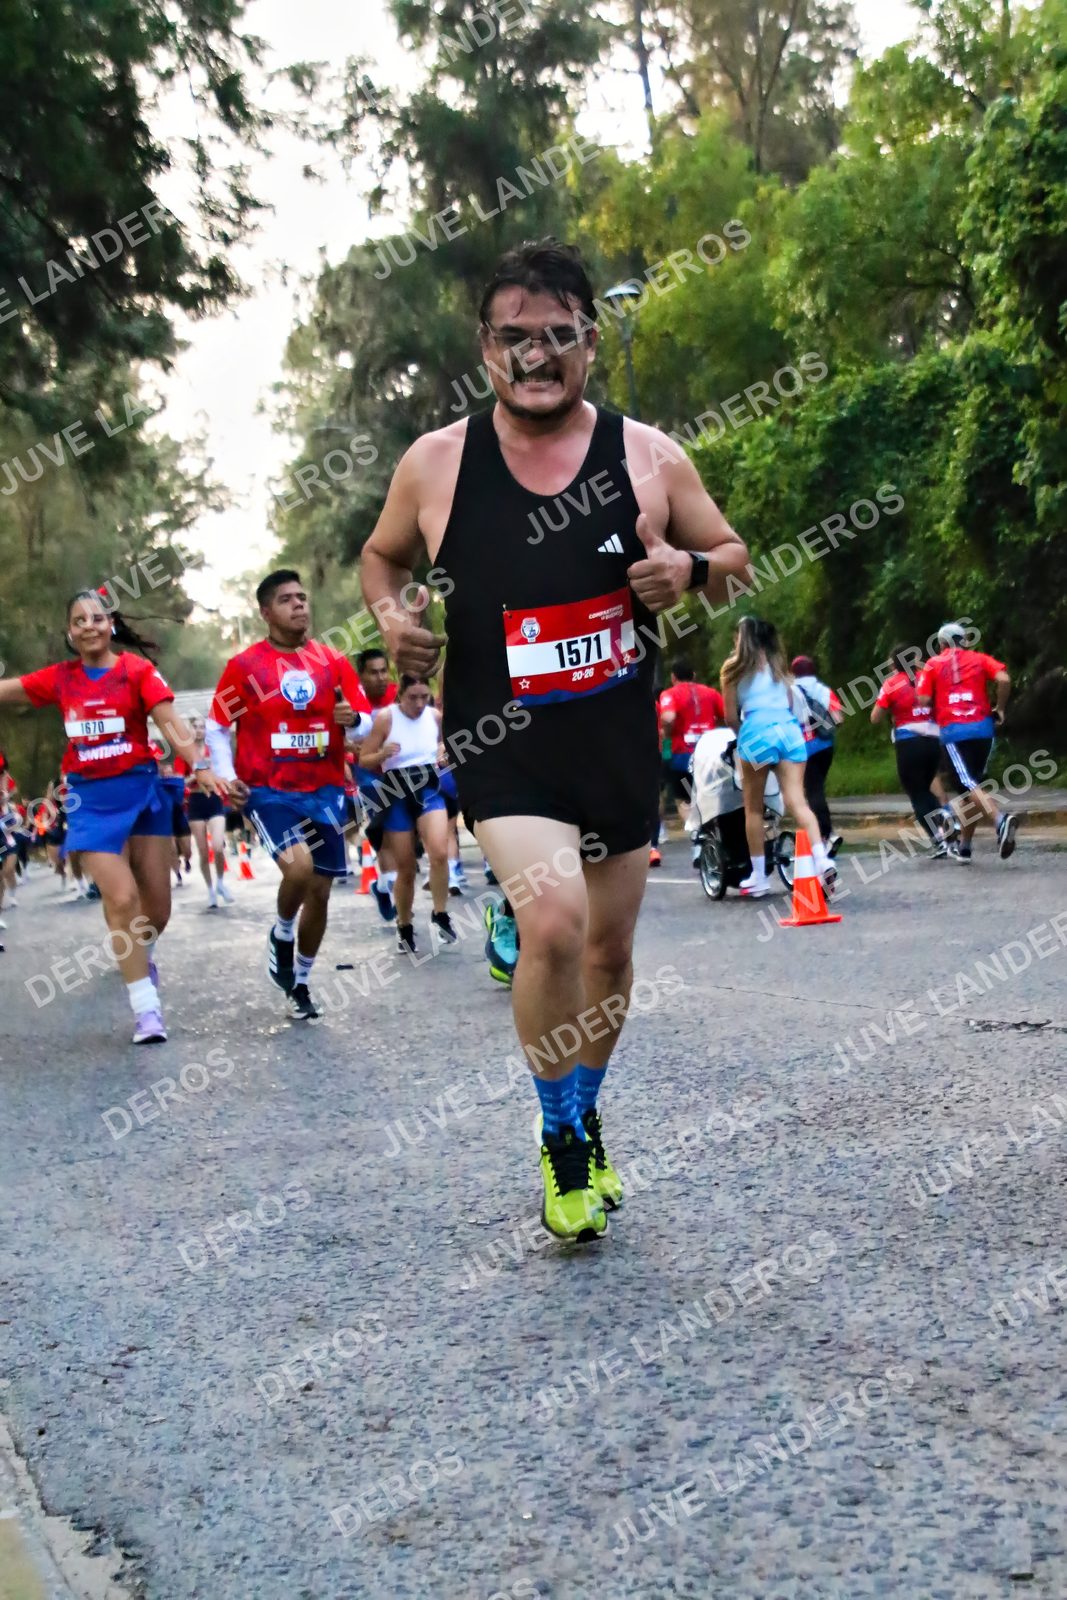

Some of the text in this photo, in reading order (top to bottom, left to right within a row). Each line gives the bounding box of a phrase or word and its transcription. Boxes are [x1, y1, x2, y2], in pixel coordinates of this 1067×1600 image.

[555, 634, 603, 669] 1571
[80, 720, 105, 735] 1670
[290, 734, 316, 748] 2021
